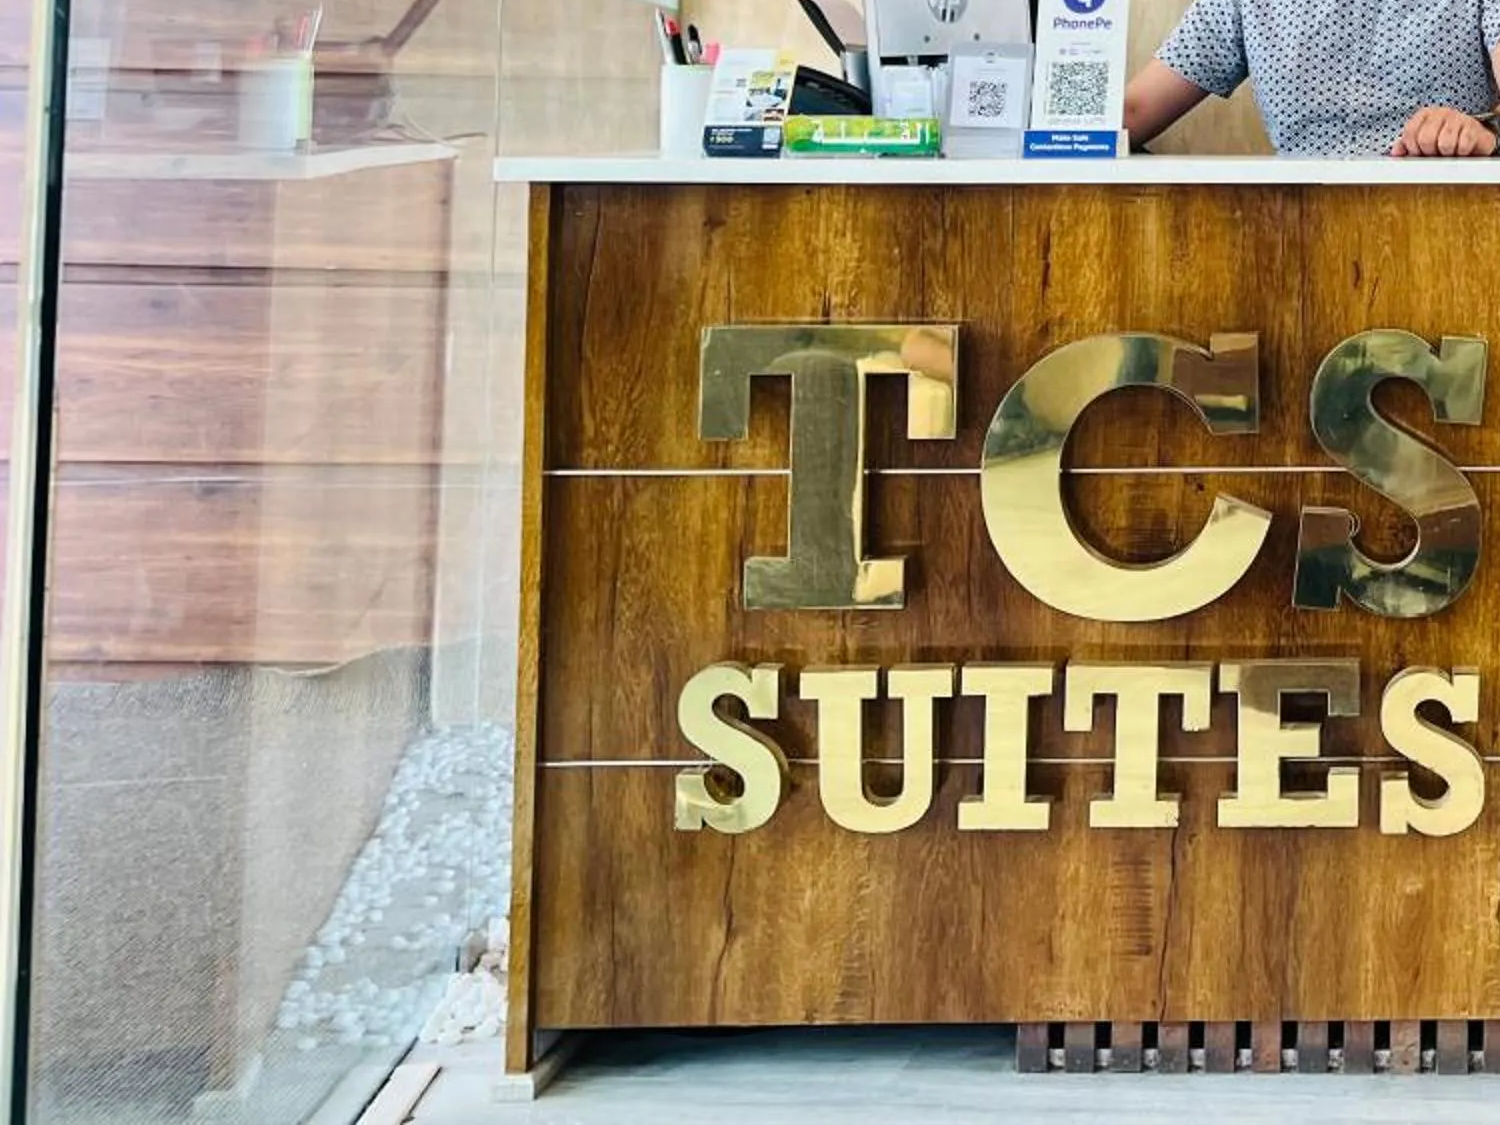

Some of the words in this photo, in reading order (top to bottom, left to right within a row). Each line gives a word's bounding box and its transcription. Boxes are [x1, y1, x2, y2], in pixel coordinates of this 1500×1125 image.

[1053, 17, 1113, 30] PhonePe
[698, 324, 1488, 623] TCS
[674, 659, 1486, 836] SUITES
